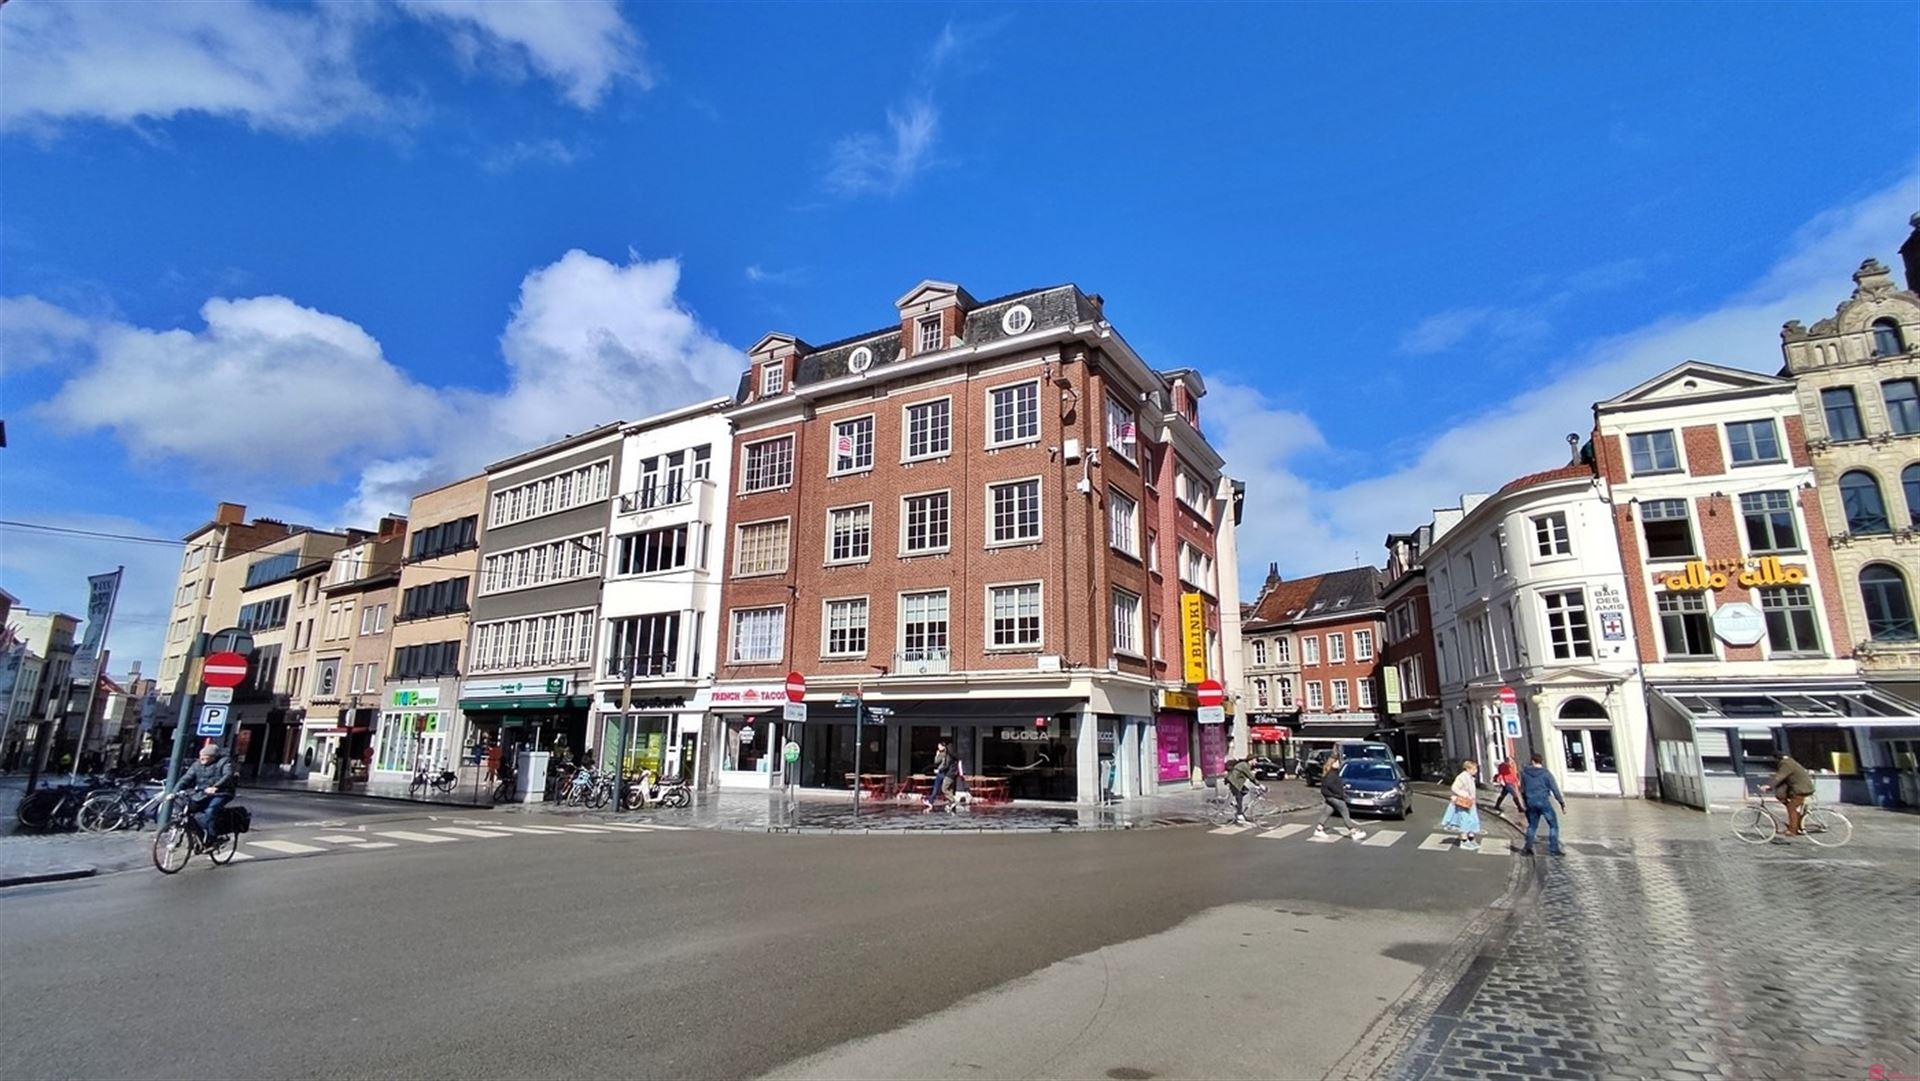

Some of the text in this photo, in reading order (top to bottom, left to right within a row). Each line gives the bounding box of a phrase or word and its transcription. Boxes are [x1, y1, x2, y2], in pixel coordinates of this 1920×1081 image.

[1189, 601, 1201, 657] BLINKI
[711, 691, 787, 701] FRENCH TACOS
[207, 709, 220, 723] P
[1001, 731, 1049, 740] BOCCA
